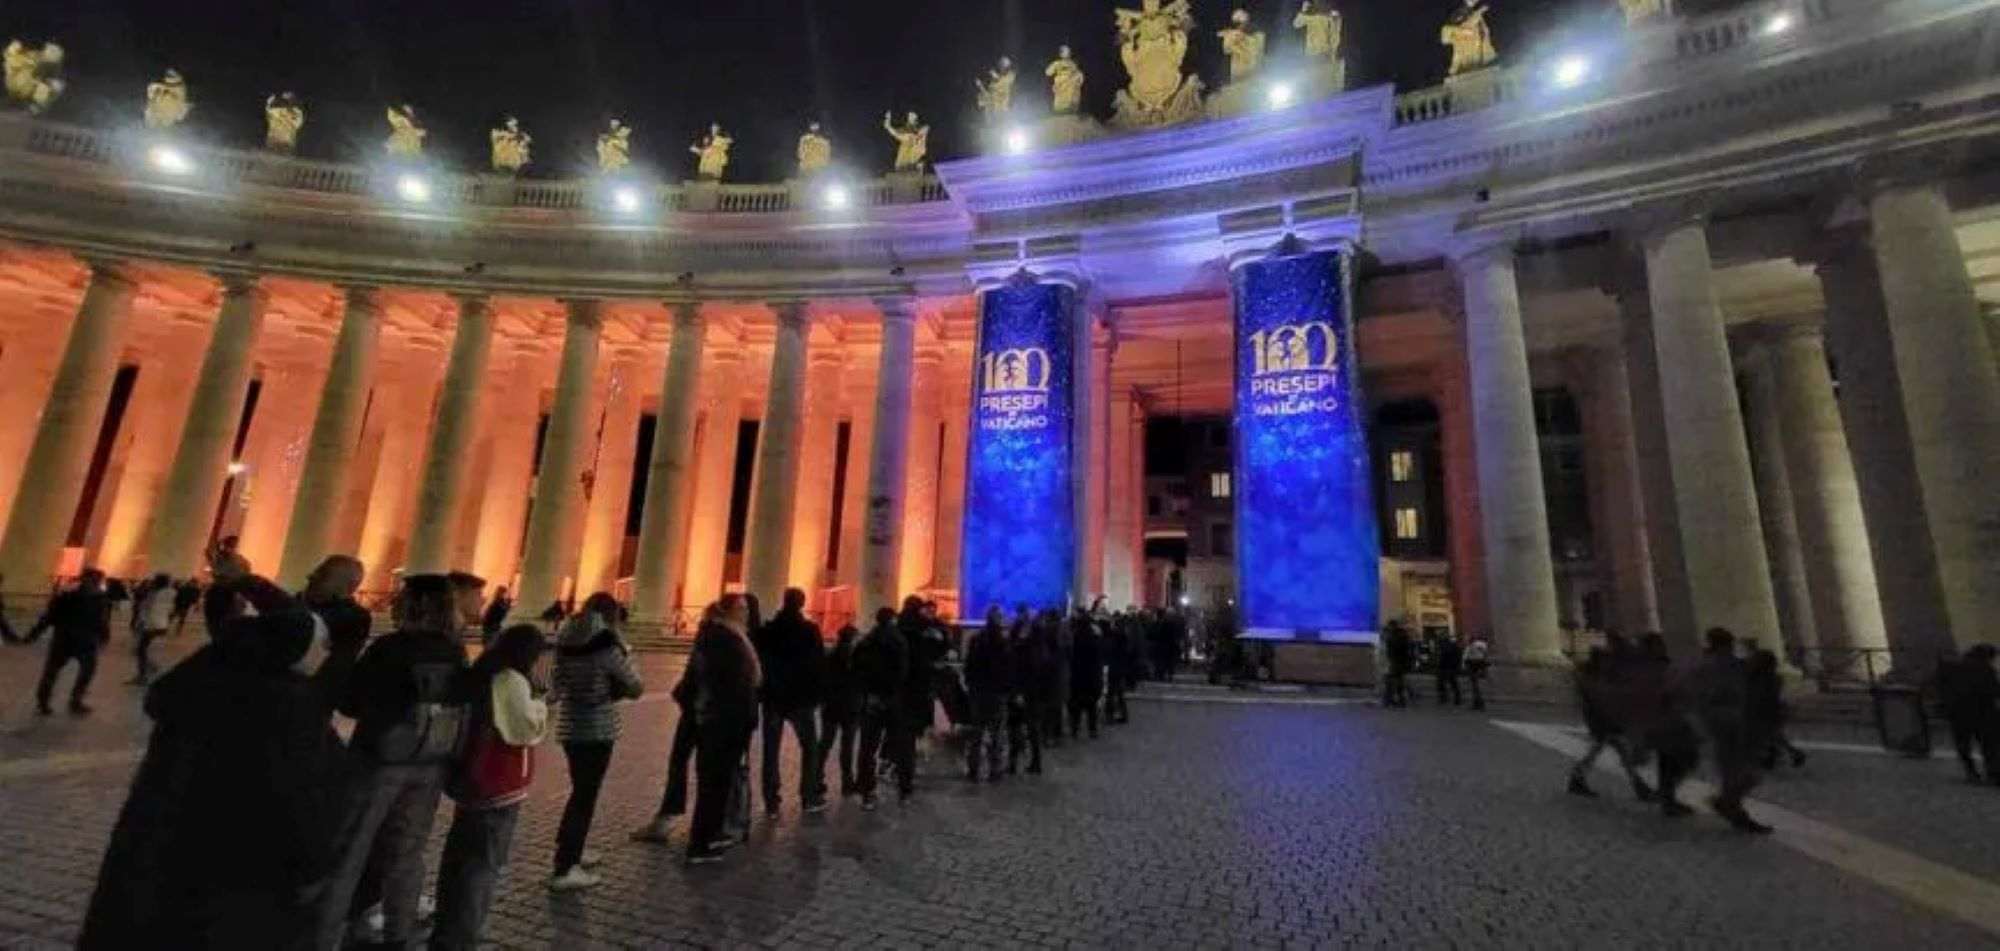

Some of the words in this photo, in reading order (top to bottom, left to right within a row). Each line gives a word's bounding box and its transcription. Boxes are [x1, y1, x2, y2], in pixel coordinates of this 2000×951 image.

[1249, 321, 1337, 374] 100
[1251, 374, 1336, 395] PRESEPI
[981, 395, 1048, 412] PRESEPI
